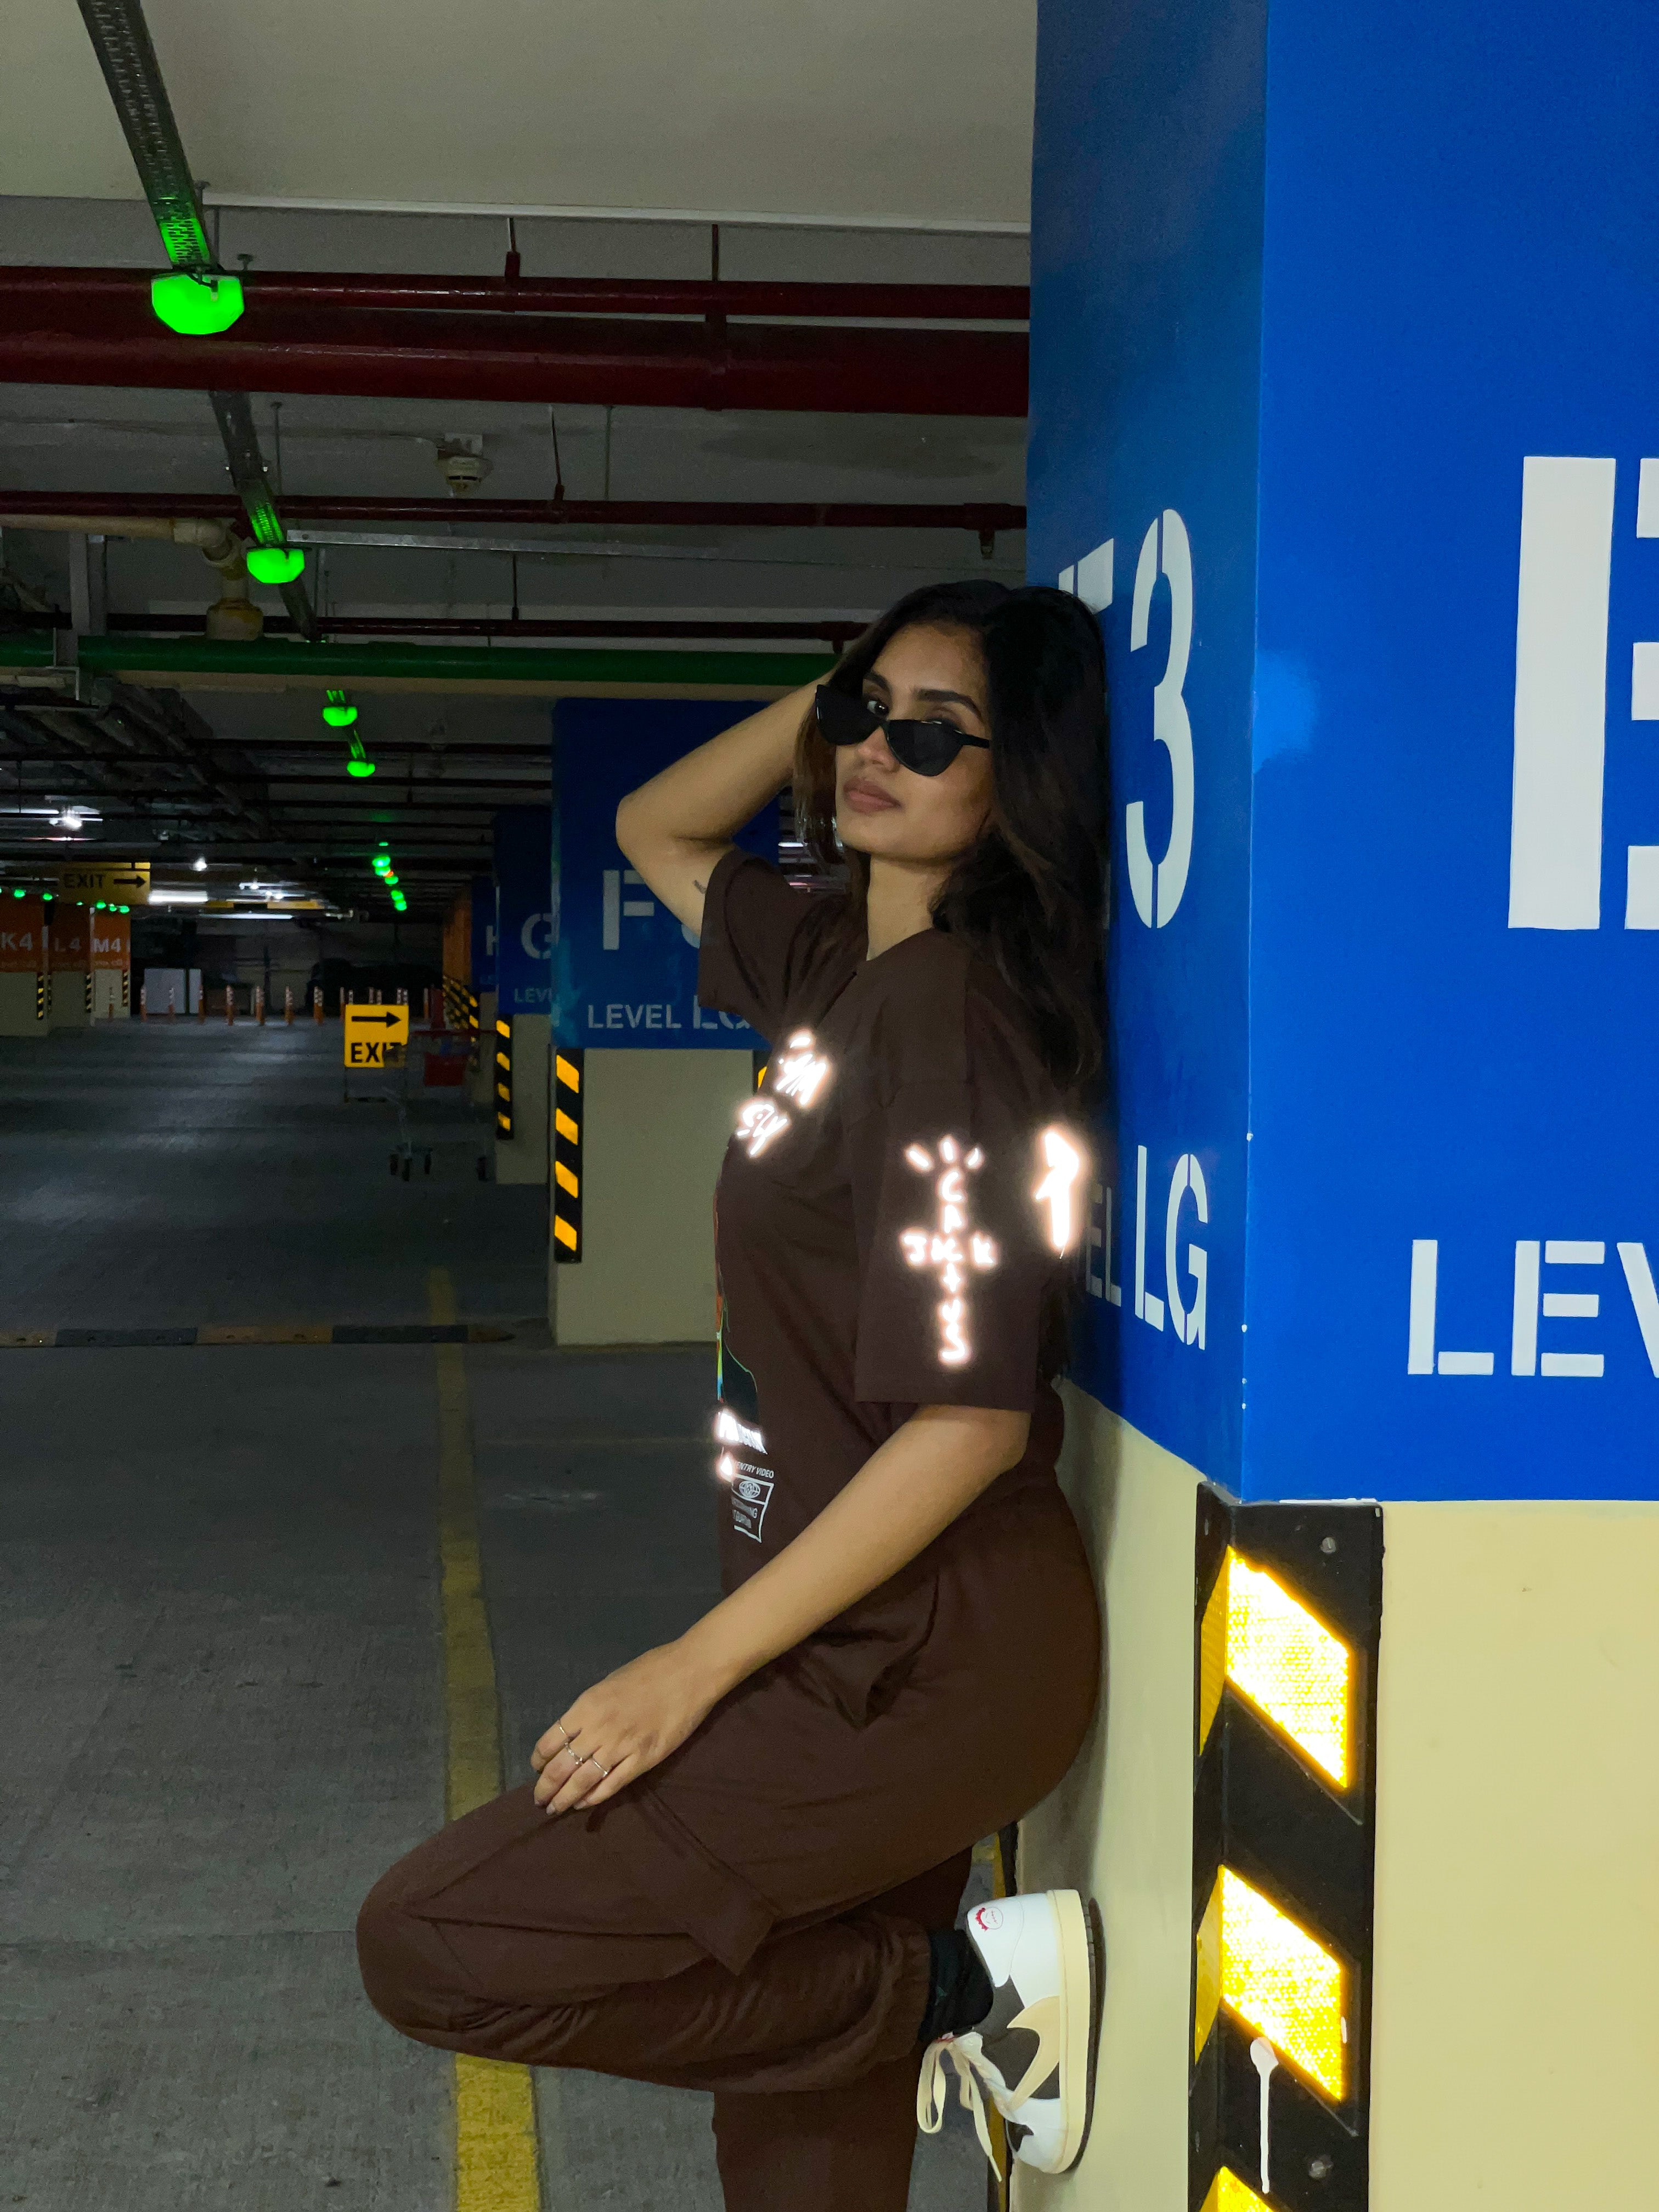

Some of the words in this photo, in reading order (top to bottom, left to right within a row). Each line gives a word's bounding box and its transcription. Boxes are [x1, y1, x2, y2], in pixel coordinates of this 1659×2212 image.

[64, 873, 106, 888] EXIT
[0, 932, 33, 952] K4
[91, 938, 121, 953] M4
[588, 1005, 682, 1029] LEVEL
[1135, 1144, 1207, 1351] LG
[756, 1467, 774, 1479] VIDEO
